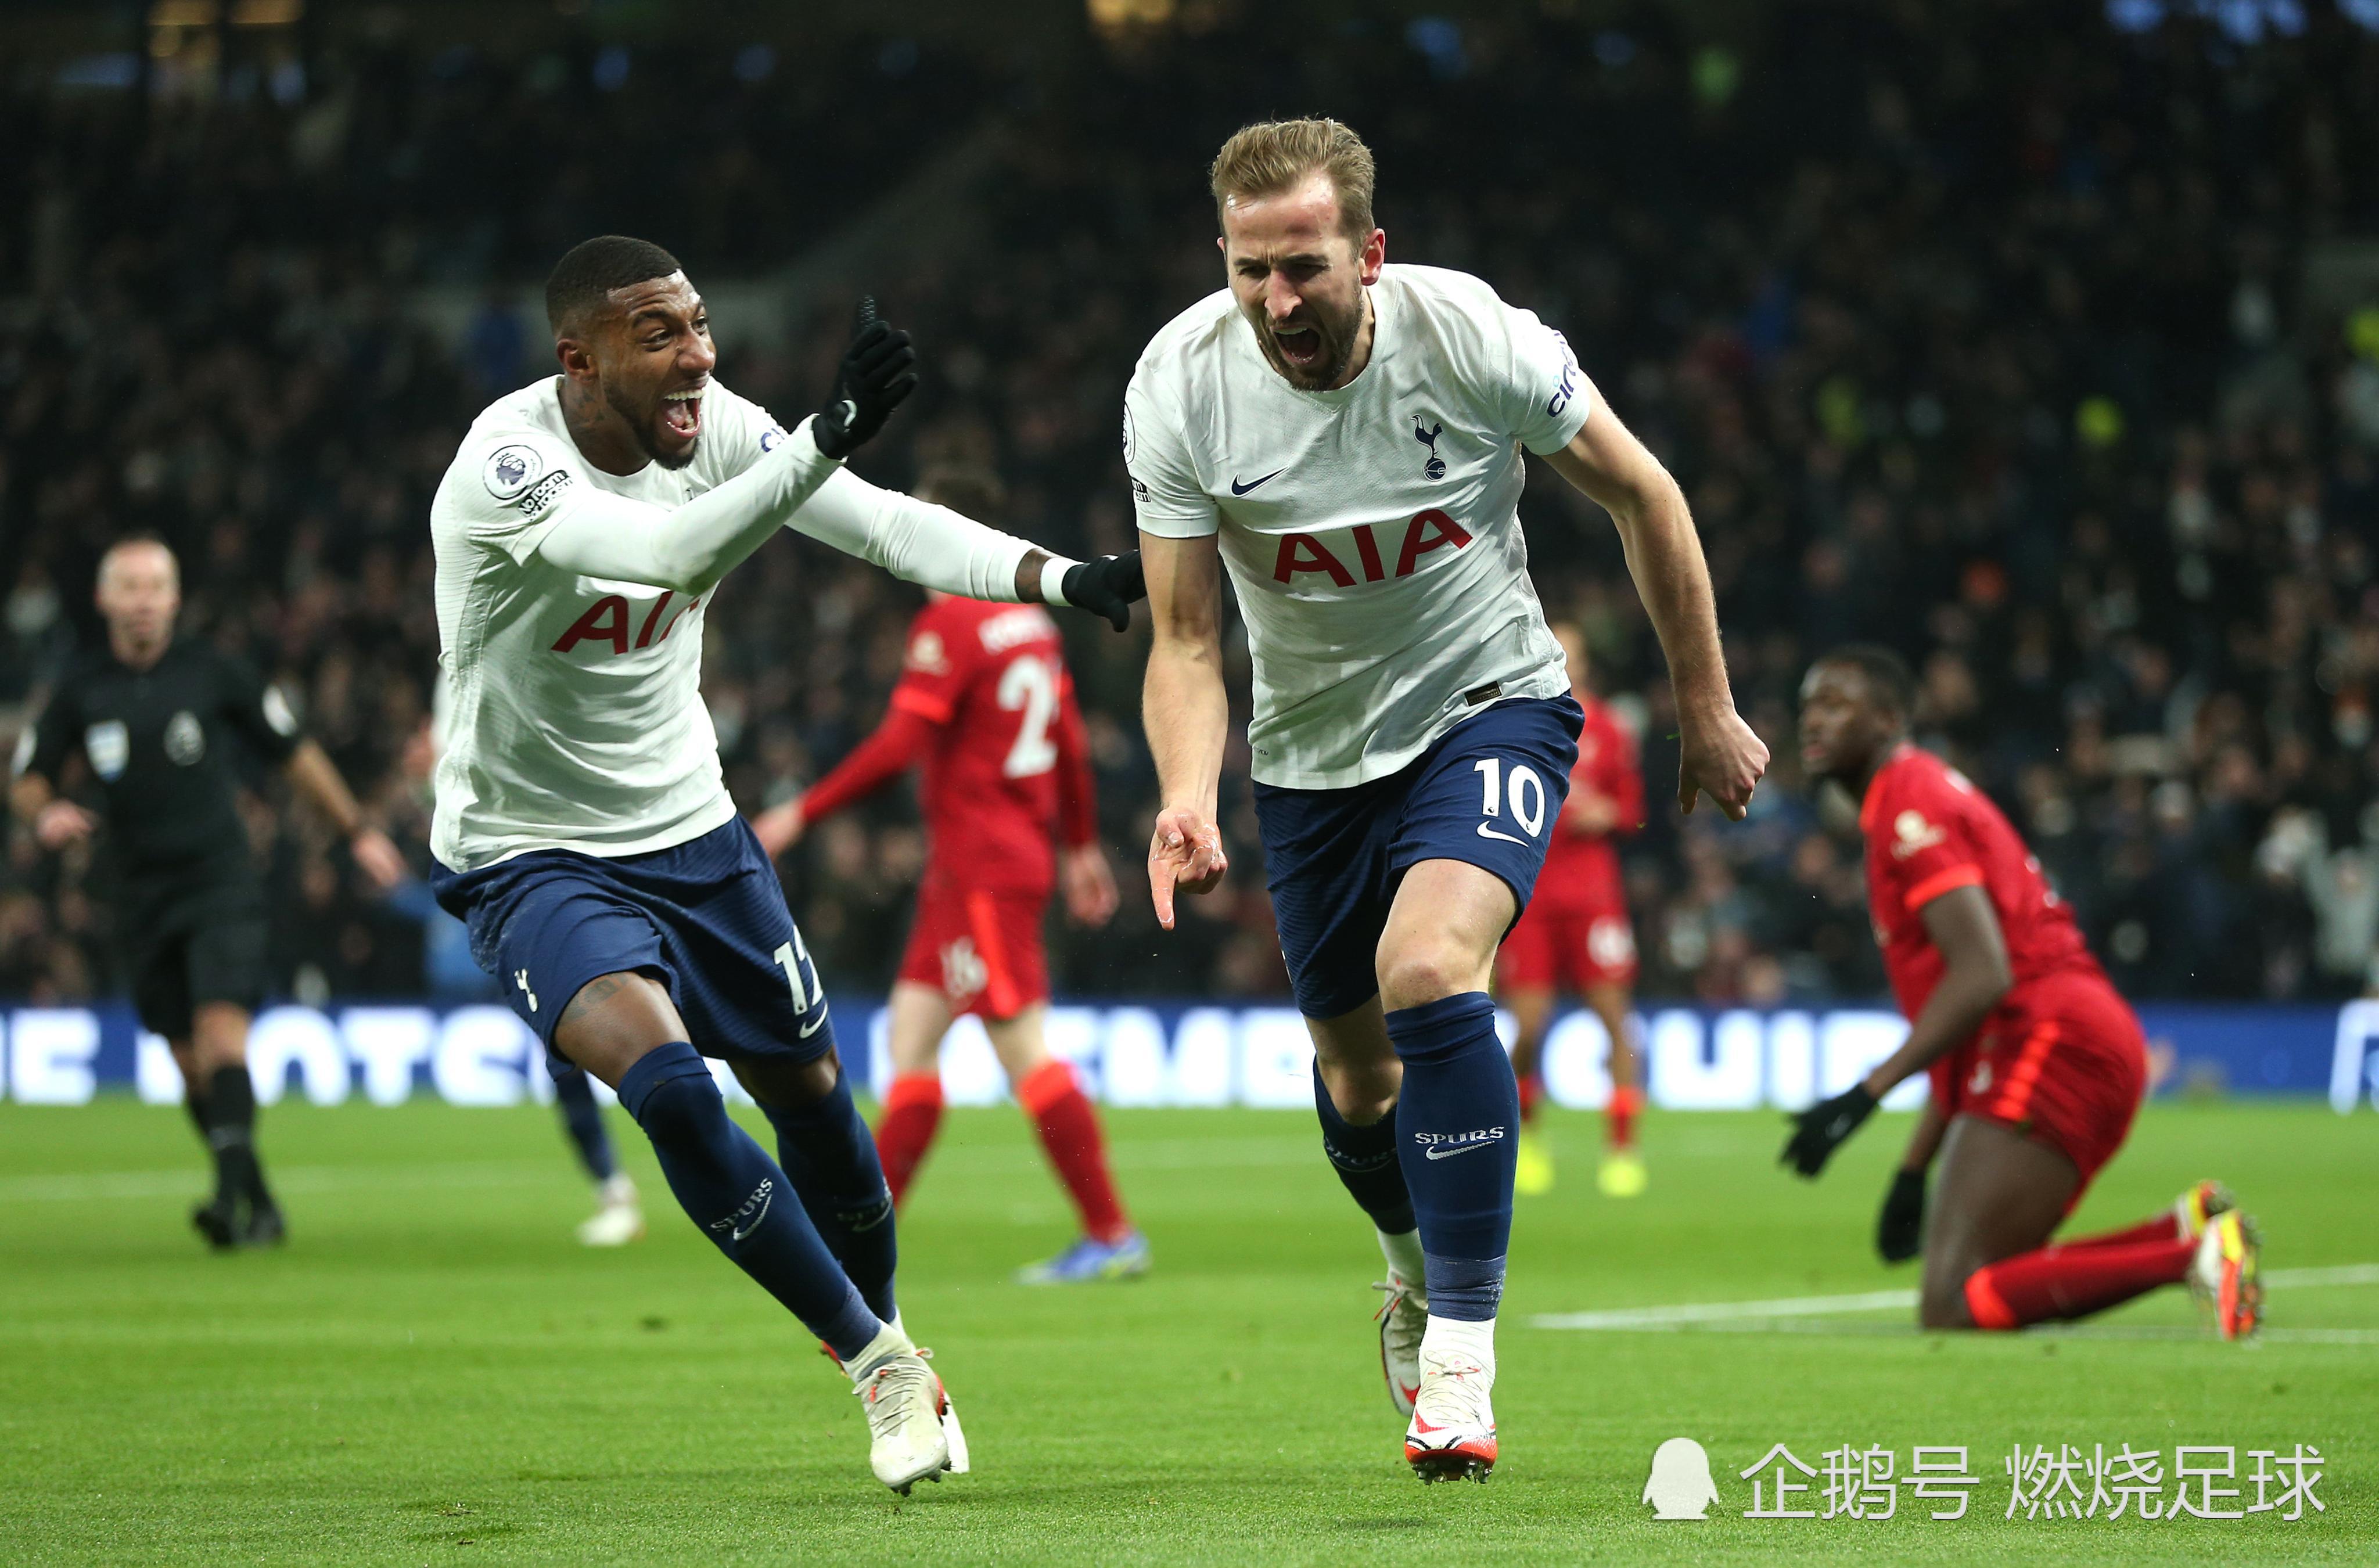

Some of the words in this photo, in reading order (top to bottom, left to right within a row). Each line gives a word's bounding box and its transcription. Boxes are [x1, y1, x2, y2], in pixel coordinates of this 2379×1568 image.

[1547, 333, 1576, 418] cin
[1273, 509, 1474, 588] AIA
[551, 591, 702, 655] AI
[997, 654, 1062, 779] 2
[1474, 758, 1545, 838] 10
[1414, 1125, 1505, 1145] SPURS
[710, 1178, 773, 1232] SPURS
